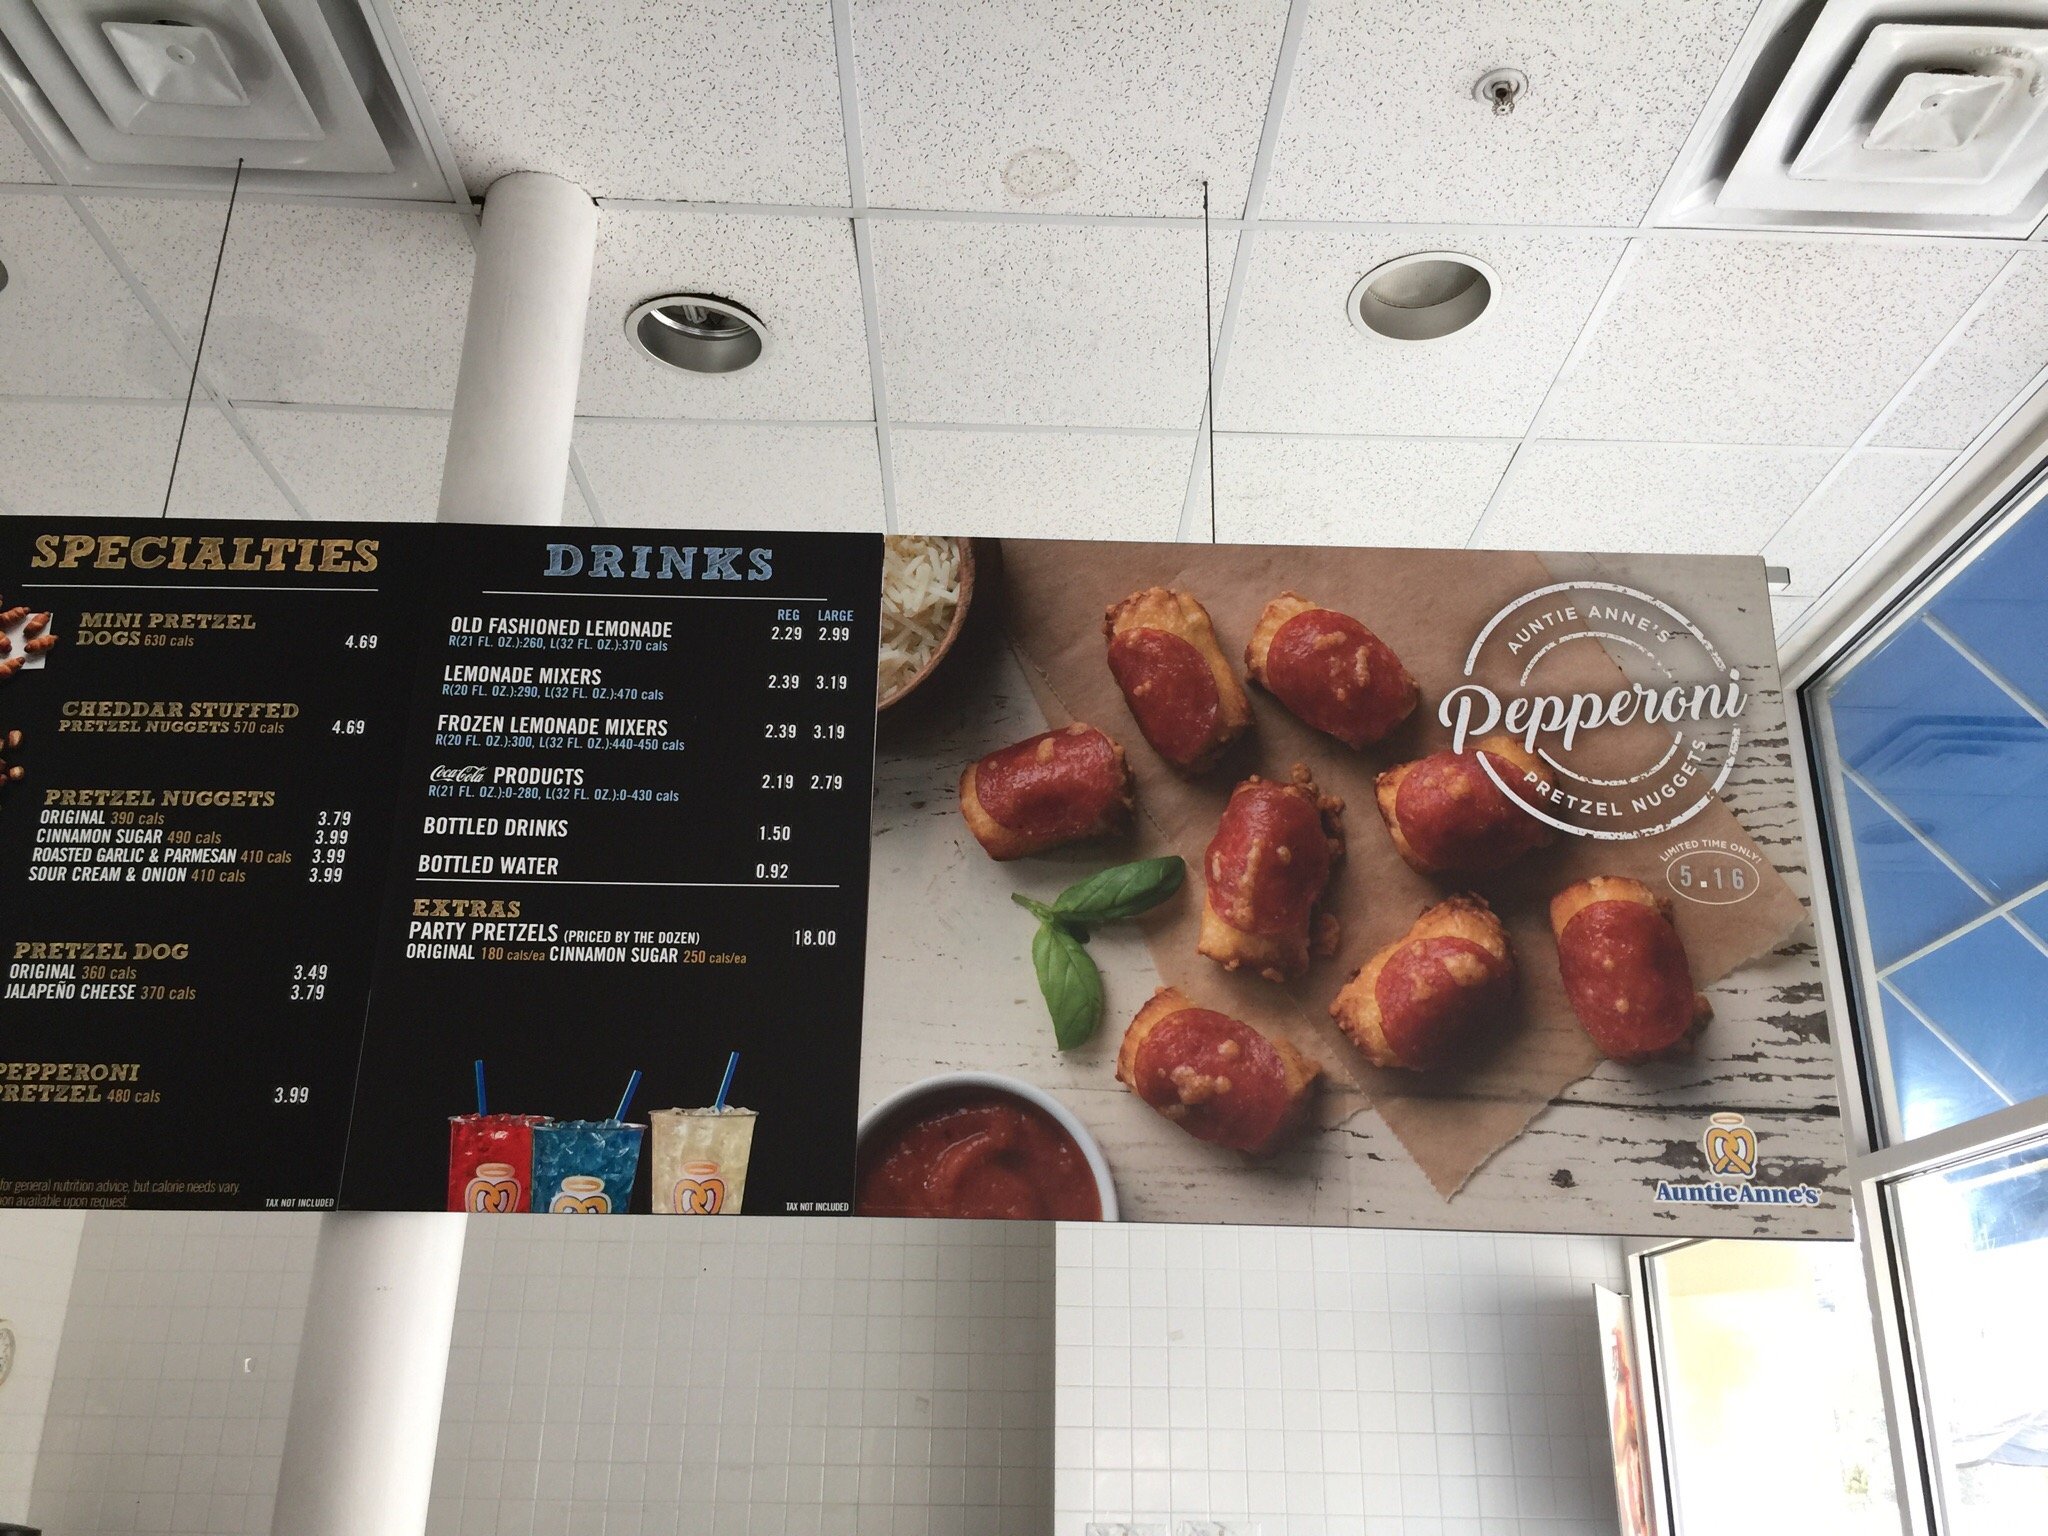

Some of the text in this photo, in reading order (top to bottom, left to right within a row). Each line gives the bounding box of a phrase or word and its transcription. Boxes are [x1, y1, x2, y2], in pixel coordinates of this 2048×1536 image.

[31, 534, 379, 573] SPECIALTIES
[543, 542, 774, 581] DRINKS
[79, 612, 256, 630] MINI PRETZEL
[777, 609, 854, 623] REG LARGE
[451, 616, 673, 638] OLD FASHIONED LEMONADE
[771, 627, 850, 642] 2.29 2.99
[1507, 605, 1671, 655] AUNTIE ANNE'S
[76, 631, 194, 647] DOGS 630 cals
[345, 634, 378, 650] 4.69
[448, 635, 473, 648] R(21
[478, 636, 493, 648] FL.
[550, 637, 574, 650] L(32
[577, 638, 593, 650] FL.
[645, 639, 668, 651] cals
[444, 665, 602, 685] LEMONADE MIXERS
[768, 675, 847, 690] 2.39 3.19
[442, 684, 468, 696] R(20
[472, 685, 487, 697] FL.
[545, 686, 568, 699] L(32
[573, 687, 588, 699] FL.
[641, 689, 664, 700] cals
[62, 701, 299, 719] CHEDDAR STUFFED
[1438, 668, 1747, 755] Pepperoni
[59, 720, 284, 734] PRETZEL NUGGETS 570 cals
[332, 719, 365, 735] 4.69
[510, 717, 599, 735] LEMONADE
[605, 718, 668, 737] MIXERS
[765, 724, 845, 740] 2.39 3.19
[435, 734, 461, 747] R(20
[465, 735, 481, 747] FL.
[539, 736, 563, 749] L(32
[567, 737, 583, 749] FL.
[662, 739, 685, 751] cals
[430, 765, 584, 786] Coca-Cola PRODUCTS
[761, 774, 843, 790] 2.19 2.79
[1523, 739, 1706, 816] PRETZEL NUGGETS
[44, 789, 275, 807] PRETZEL NUGGETS
[428, 785, 454, 798] R(21
[459, 786, 475, 798] FL.
[546, 787, 570, 800] L(32
[574, 788, 590, 800] FL.
[656, 790, 679, 802] cals
[40, 810, 164, 825] ORIGINAL 390 cals
[318, 811, 351, 826] 3.79
[423, 816, 568, 838] BOTTLED DRINKS
[759, 825, 791, 841] 1.50
[36, 829, 221, 844] CINNAMON SUGAR 490 cals
[315, 830, 348, 845] 3.99
[32, 847, 291, 864] ROASTED GARLIC & PARMESAN 410 cals
[312, 849, 345, 864] 3.99
[1660, 839, 1762, 864] LIMITED TIME ONLY!
[418, 854, 559, 875] BOTTLED WATER
[756, 863, 789, 879] 0.92
[28, 867, 246, 883] SOUR CREAM & ONION 410 cals
[309, 868, 343, 883] 3.99
[412, 899, 521, 918] EXTRAS
[409, 921, 466, 940] PARTY
[471, 922, 558, 942] PRETZELS
[564, 930, 611, 944] (PRICED
[615, 931, 630, 944] BY
[634, 931, 654, 944] THE
[794, 929, 836, 946] 18.00
[13, 942, 189, 960] PRETZEL DOG
[406, 943, 747, 965] ORIGINAL 180 cals/ea CINNAMON SUGAR 250 cals/ea
[9, 963, 137, 980] ORIGINAL 360 cals
[294, 964, 328, 980] 3.49
[4, 981, 196, 1000] JALAPEÑO CHEESE 370 cals
[290, 984, 325, 1000] 3.79
[0, 1084, 161, 1103] RETZEL 480 cals
[274, 1086, 309, 1104] 3.99
[266, 1198, 335, 1207] TAX NOT INCLUDED
[786, 1202, 849, 1211] TAX NOT INCLUDED
